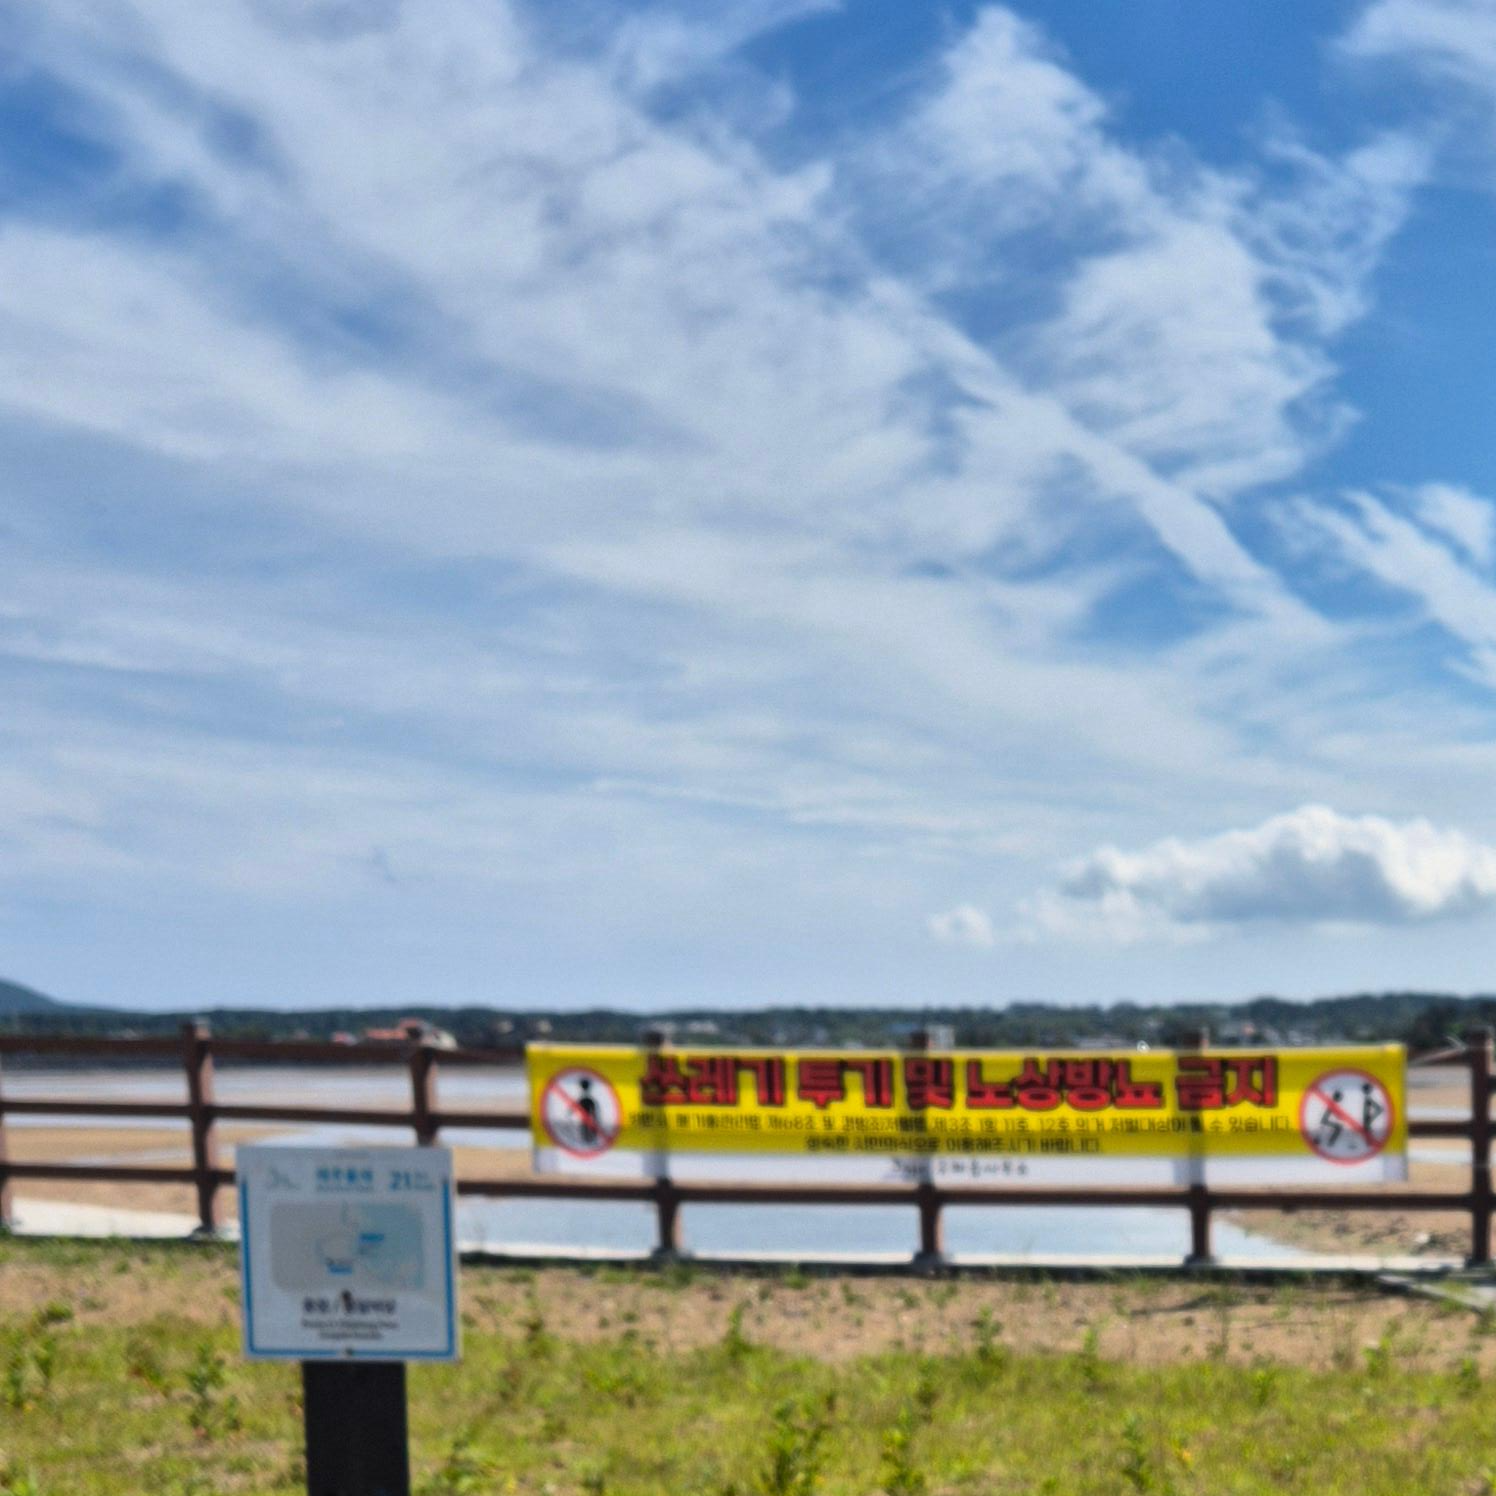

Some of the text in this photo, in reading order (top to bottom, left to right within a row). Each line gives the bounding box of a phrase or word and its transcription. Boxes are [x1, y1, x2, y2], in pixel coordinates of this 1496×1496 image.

[641, 1053, 1278, 1112] 쓰레기 투기 및 노상방뇨 금지
